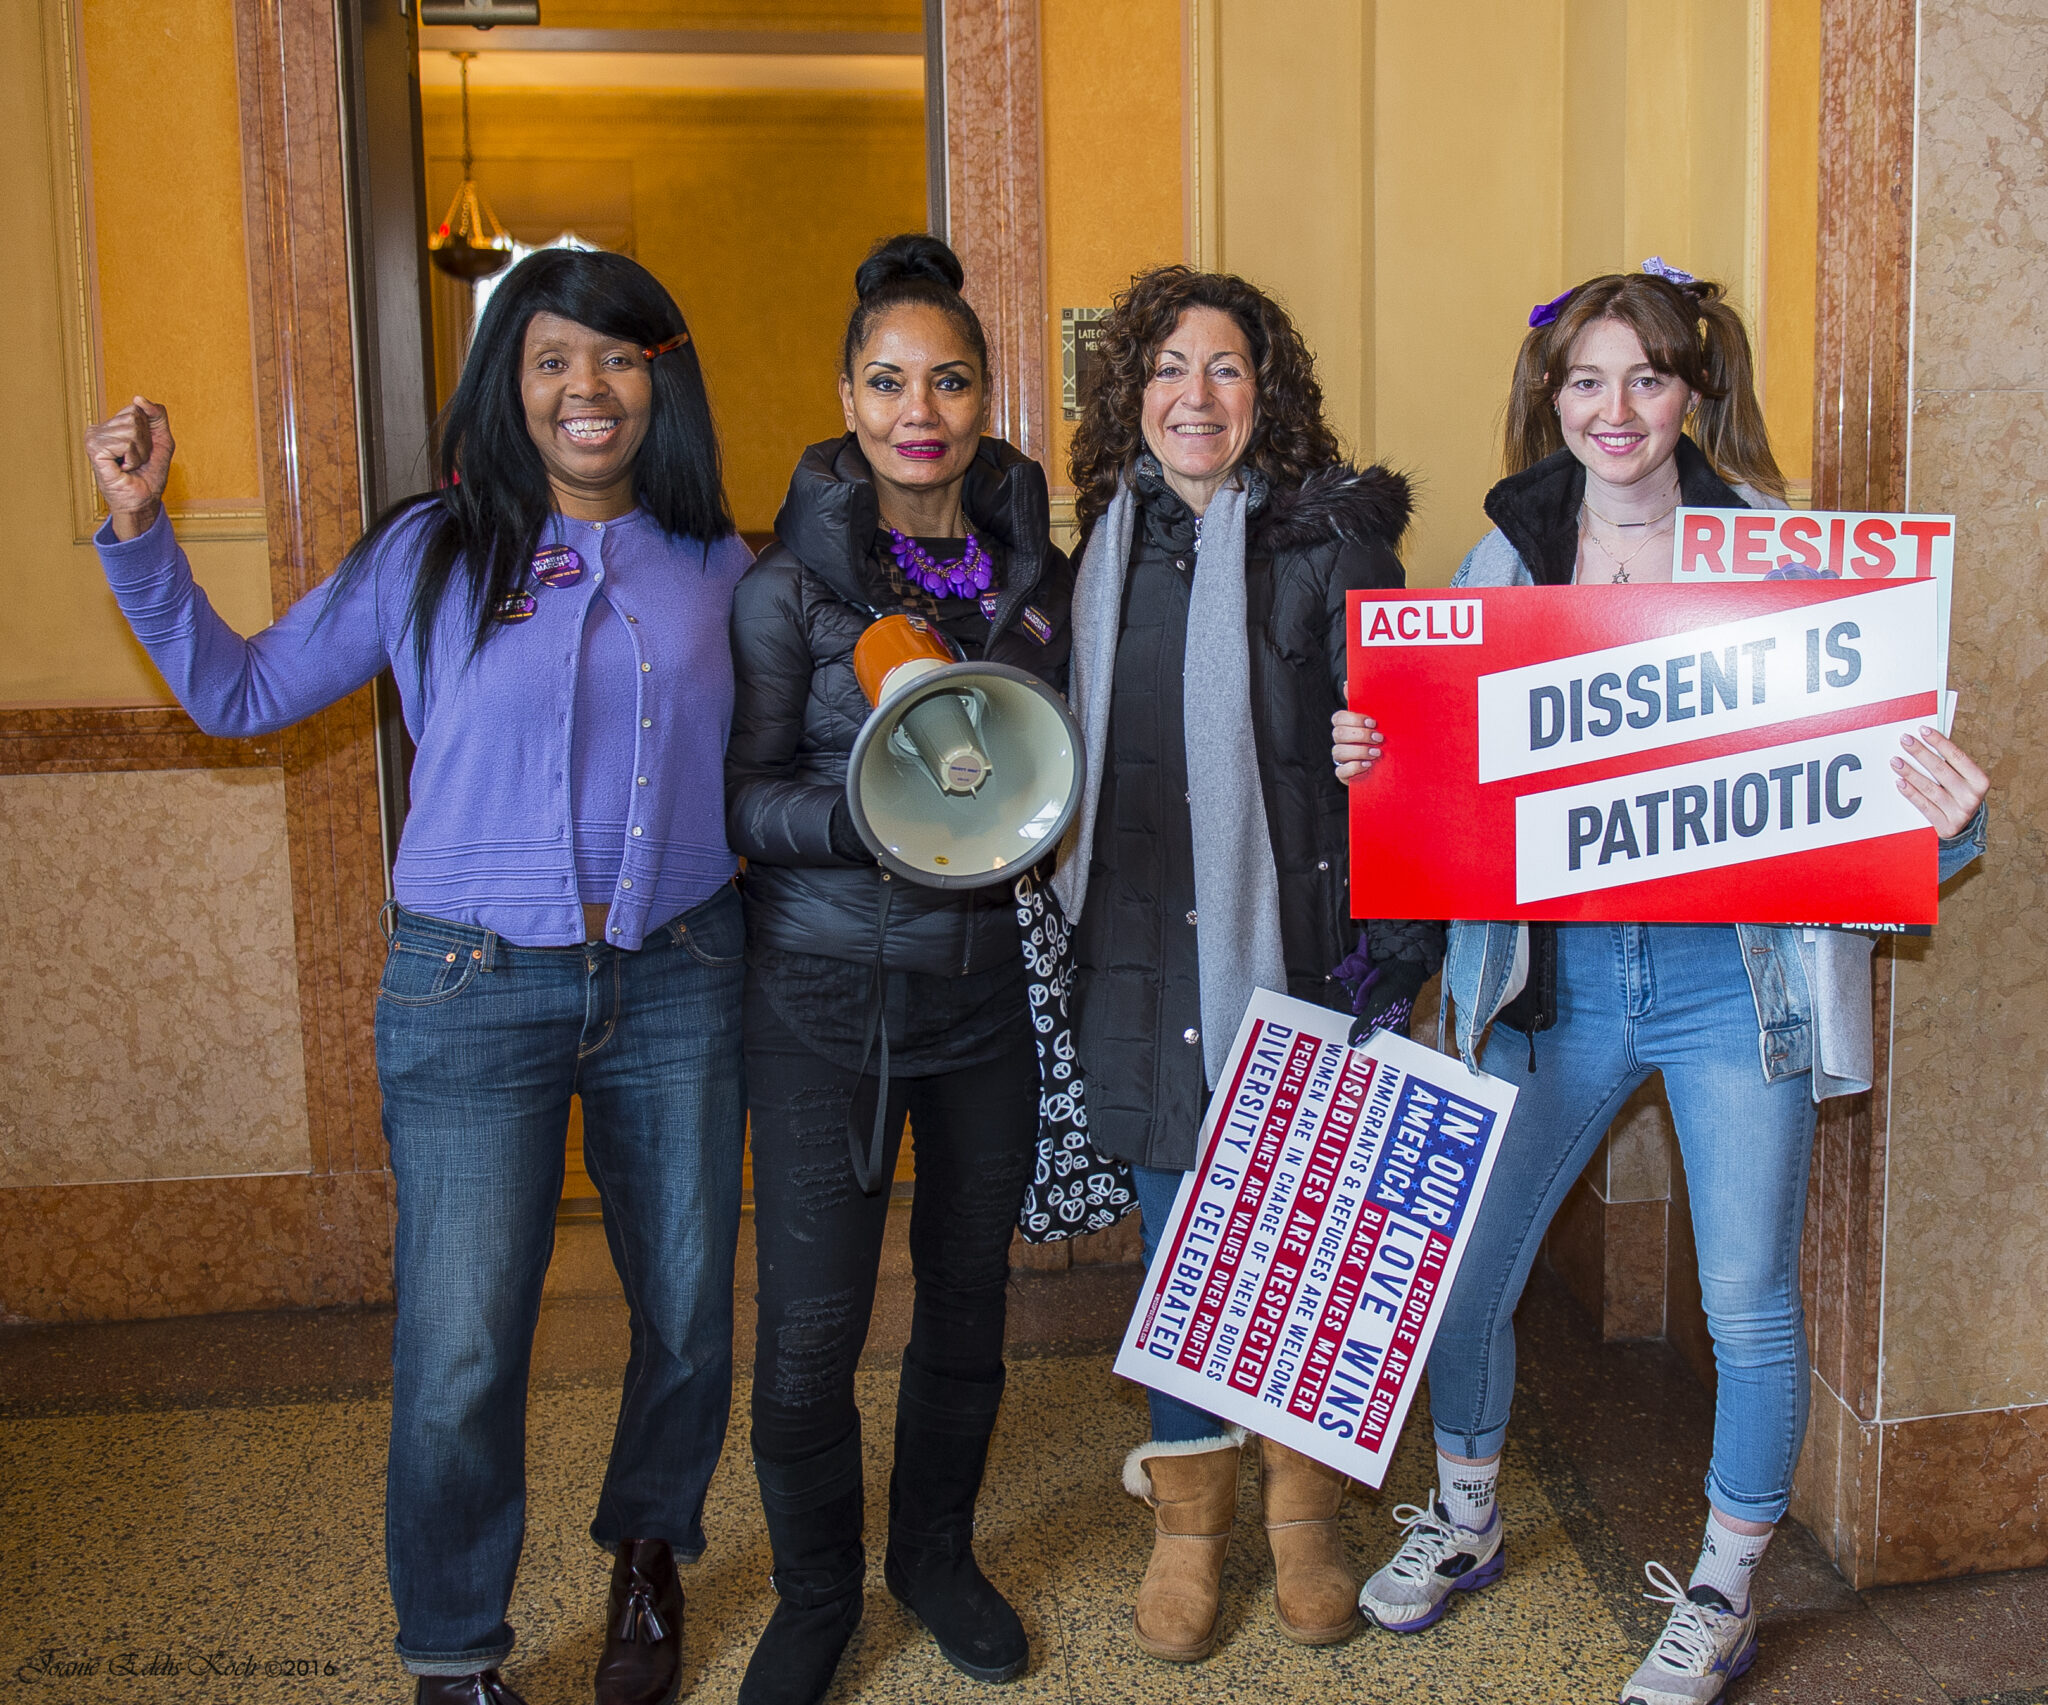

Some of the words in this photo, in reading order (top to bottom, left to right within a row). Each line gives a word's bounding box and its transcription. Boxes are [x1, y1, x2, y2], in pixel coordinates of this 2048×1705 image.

[1079, 329, 1095, 339] LATE
[1681, 514, 1951, 578] RESIST
[1368, 606, 1475, 641] ACLU
[1529, 637, 1776, 752] DISSENT
[1806, 621, 1863, 695] IS
[1568, 753, 1863, 872] PATRIOTIC
[1222, 1020, 1292, 1154] DIVERSITY
[1281, 1038, 1314, 1094] PEOPLE
[1307, 1041, 1343, 1103] WOMEN
[1275, 1097, 1292, 1112] &
[1293, 1107, 1318, 1141] ARE
[1301, 1058, 1370, 1203] DISABILITIES
[1347, 1063, 1401, 1174] IMMIGRANTS
[1437, 1099, 1484, 1146] IN
[1253, 1114, 1286, 1172] PLANET
[1284, 1146, 1304, 1167] IN
[1375, 1083, 1440, 1208] AMERICA
[1208, 1162, 1239, 1192] IS
[1240, 1175, 1264, 1206] ARE
[1258, 1170, 1295, 1236] CHARGE
[1341, 1174, 1361, 1191] &
[1409, 1151, 1466, 1228] OUR
[1218, 1209, 1251, 1266] VALUED
[1248, 1239, 1270, 1263] OF
[1282, 1208, 1316, 1256] ARE
[1308, 1193, 1355, 1282] REFUGEES
[1345, 1207, 1382, 1270] BLACK
[1421, 1237, 1447, 1272] ALL
[1146, 1199, 1225, 1362] CELEBRATED
[1203, 1268, 1230, 1308] OVER
[1228, 1267, 1259, 1318] THEIR
[1358, 1219, 1424, 1323] LOVE
[1232, 1261, 1296, 1389] RESPECTED
[1294, 1283, 1322, 1320] ARE
[1322, 1274, 1358, 1332] LIVES
[1395, 1276, 1433, 1343] PEOPLE
[1181, 1310, 1214, 1365] PROFIT
[1205, 1322, 1239, 1382] BODIES
[1262, 1321, 1308, 1408] WELCOME
[1381, 1346, 1408, 1384] ARE
[1292, 1336, 1335, 1414] MATTER
[1315, 1335, 1383, 1441] WINS
[1359, 1387, 1394, 1444] EQUAL
[1453, 1481, 1491, 1491] SHUT
